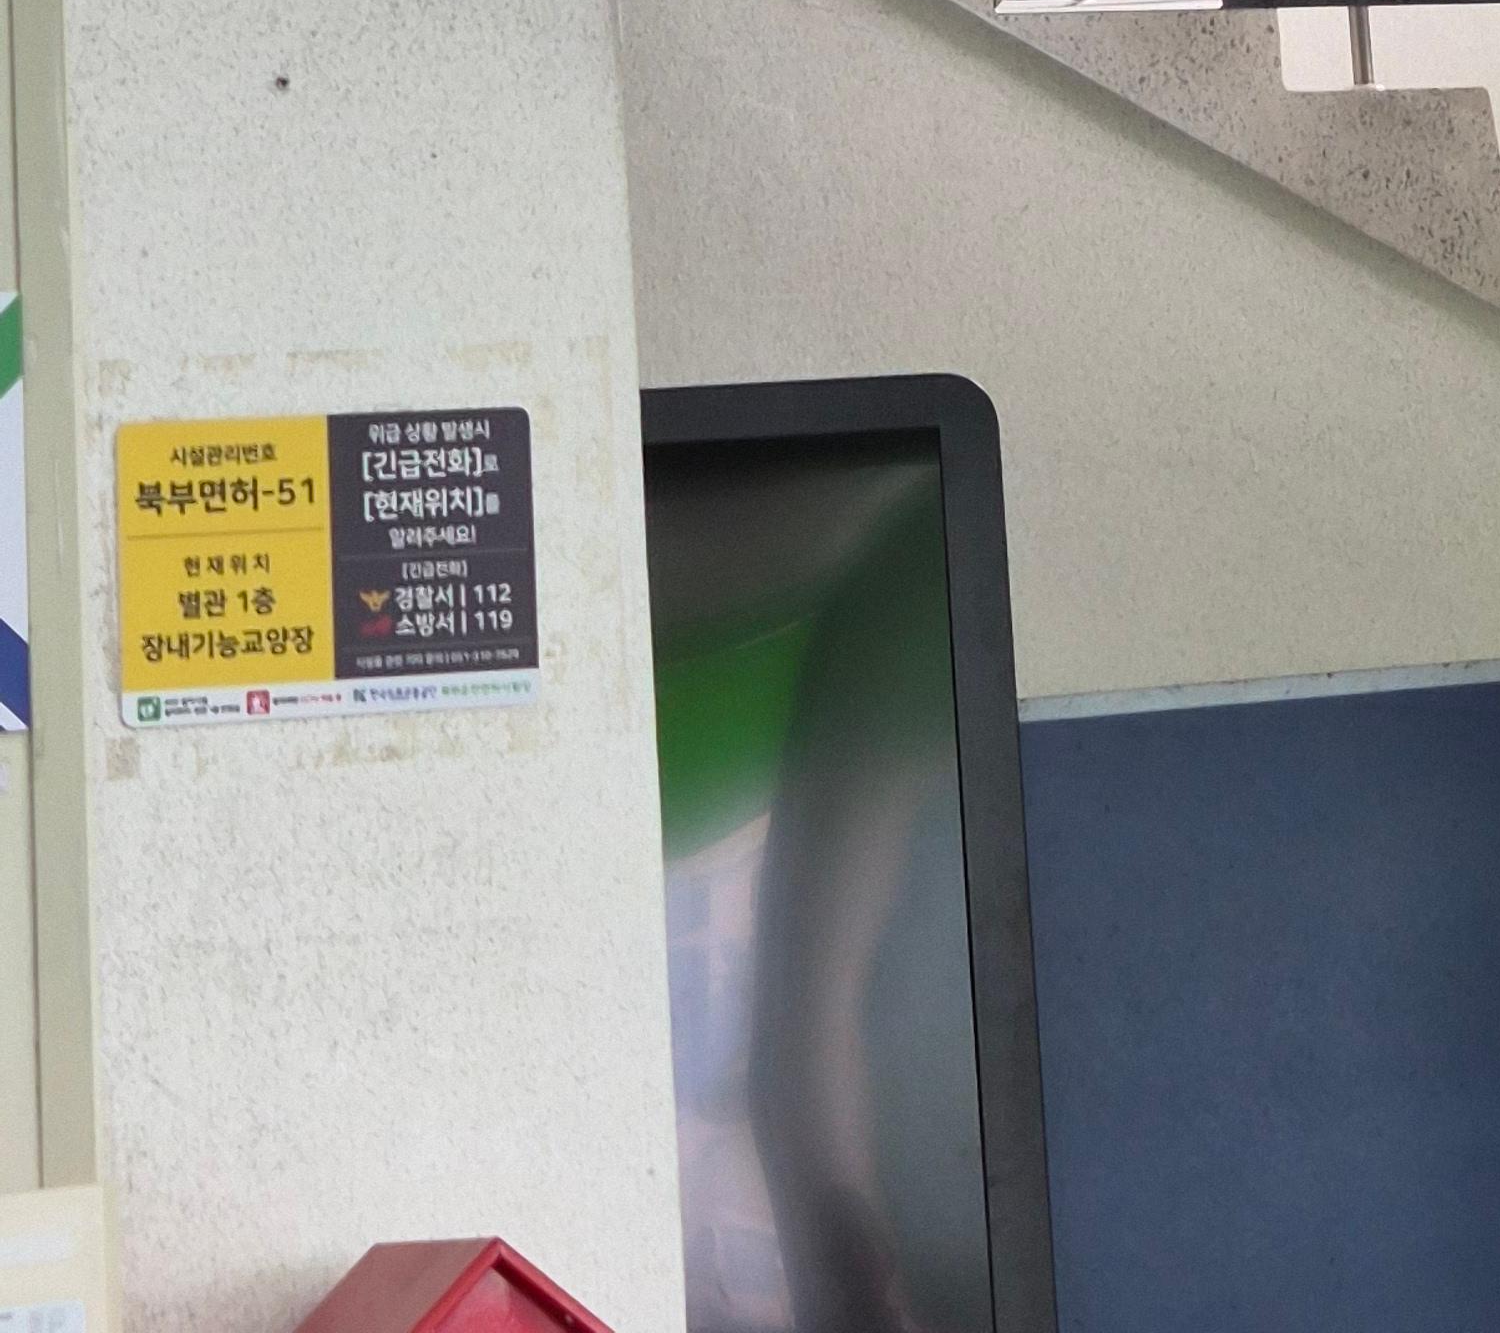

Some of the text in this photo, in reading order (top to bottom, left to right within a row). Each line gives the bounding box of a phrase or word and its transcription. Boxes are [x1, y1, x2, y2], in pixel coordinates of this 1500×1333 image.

[170, 442, 278, 467] 시설관리번호
[135, 476, 316, 517] 북부면허-51
[178, 585, 277, 620] 별관 1층
[395, 582, 513, 612] 경찰서 112
[395, 609, 514, 637] 소방서 119
[142, 625, 315, 663] 장내기능교양장
